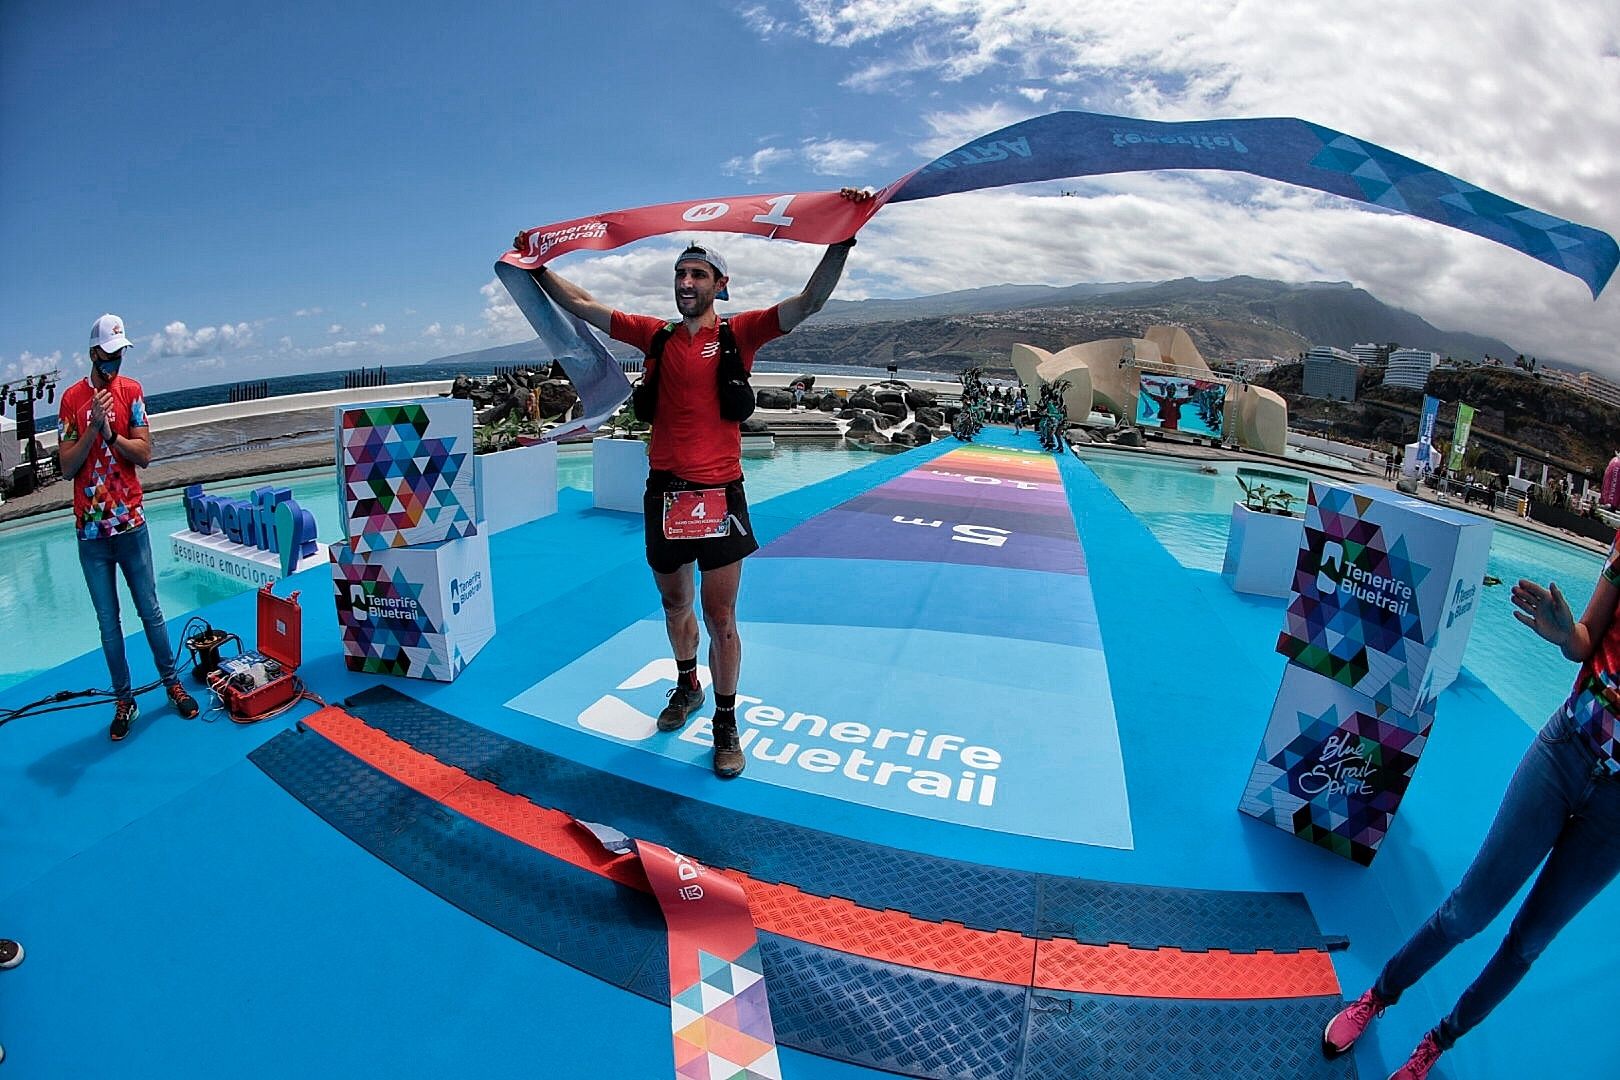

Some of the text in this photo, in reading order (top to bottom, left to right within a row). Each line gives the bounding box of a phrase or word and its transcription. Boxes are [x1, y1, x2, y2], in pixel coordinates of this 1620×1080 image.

[752, 194, 797, 227] 1
[540, 230, 607, 256] Bluetrail
[541, 222, 608, 243] Tenerife
[691, 502, 706, 519] 4
[173, 541, 215, 568] despierta
[1343, 560, 1412, 600] Tenerife
[367, 594, 417, 609] Tenerife
[1340, 577, 1409, 617] Bluetrail
[368, 606, 418, 621] Bluetrail
[1319, 731, 1365, 762] Blue
[678, 715, 998, 807] Bluetrail
[1328, 753, 1378, 779] Trail
[1298, 764, 1374, 801] Spirit
